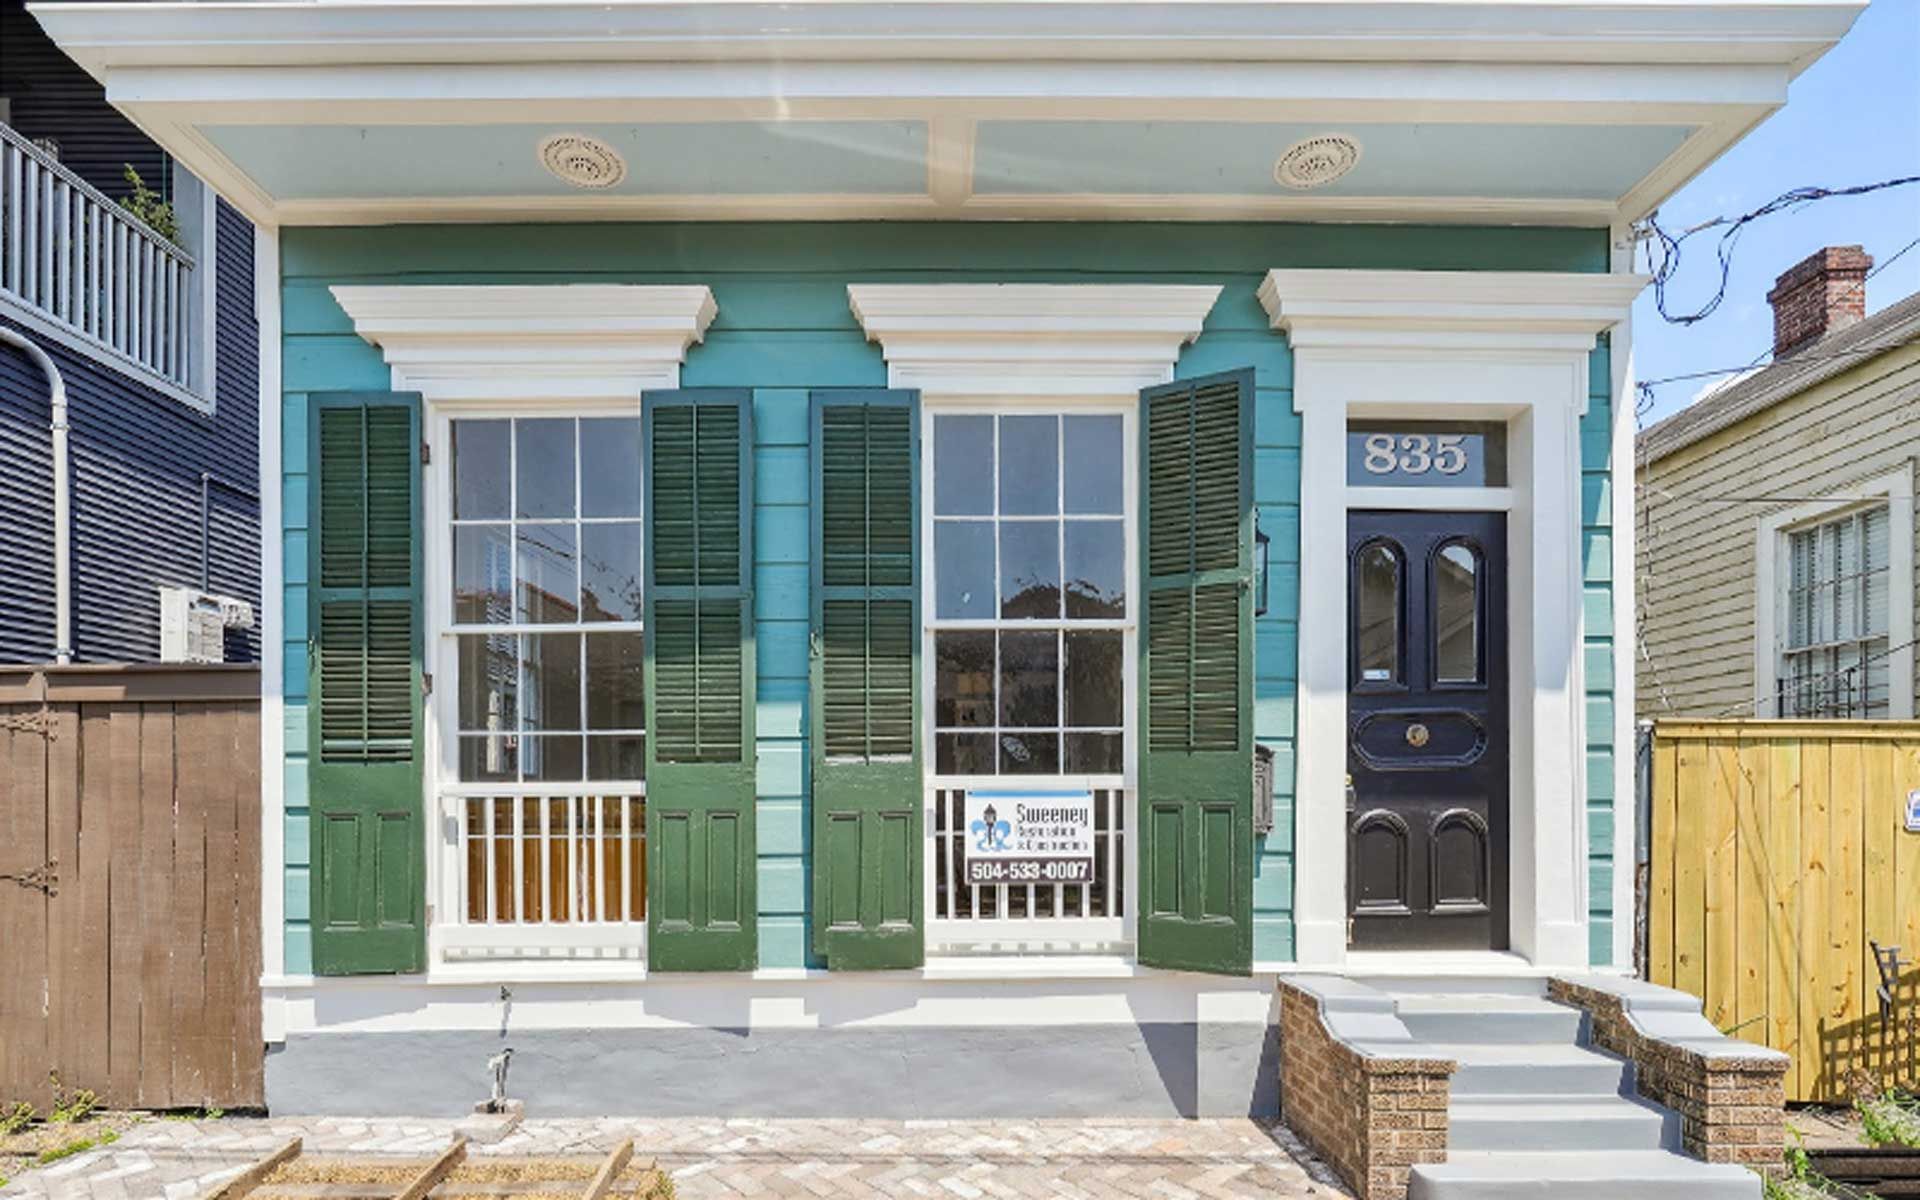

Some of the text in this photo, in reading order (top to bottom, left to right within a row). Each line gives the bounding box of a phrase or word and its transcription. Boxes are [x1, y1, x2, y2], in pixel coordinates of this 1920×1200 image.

[1364, 434, 1467, 475] 835
[1016, 803, 1088, 827] Sweeney
[971, 861, 1088, 879] 504-533-0007
